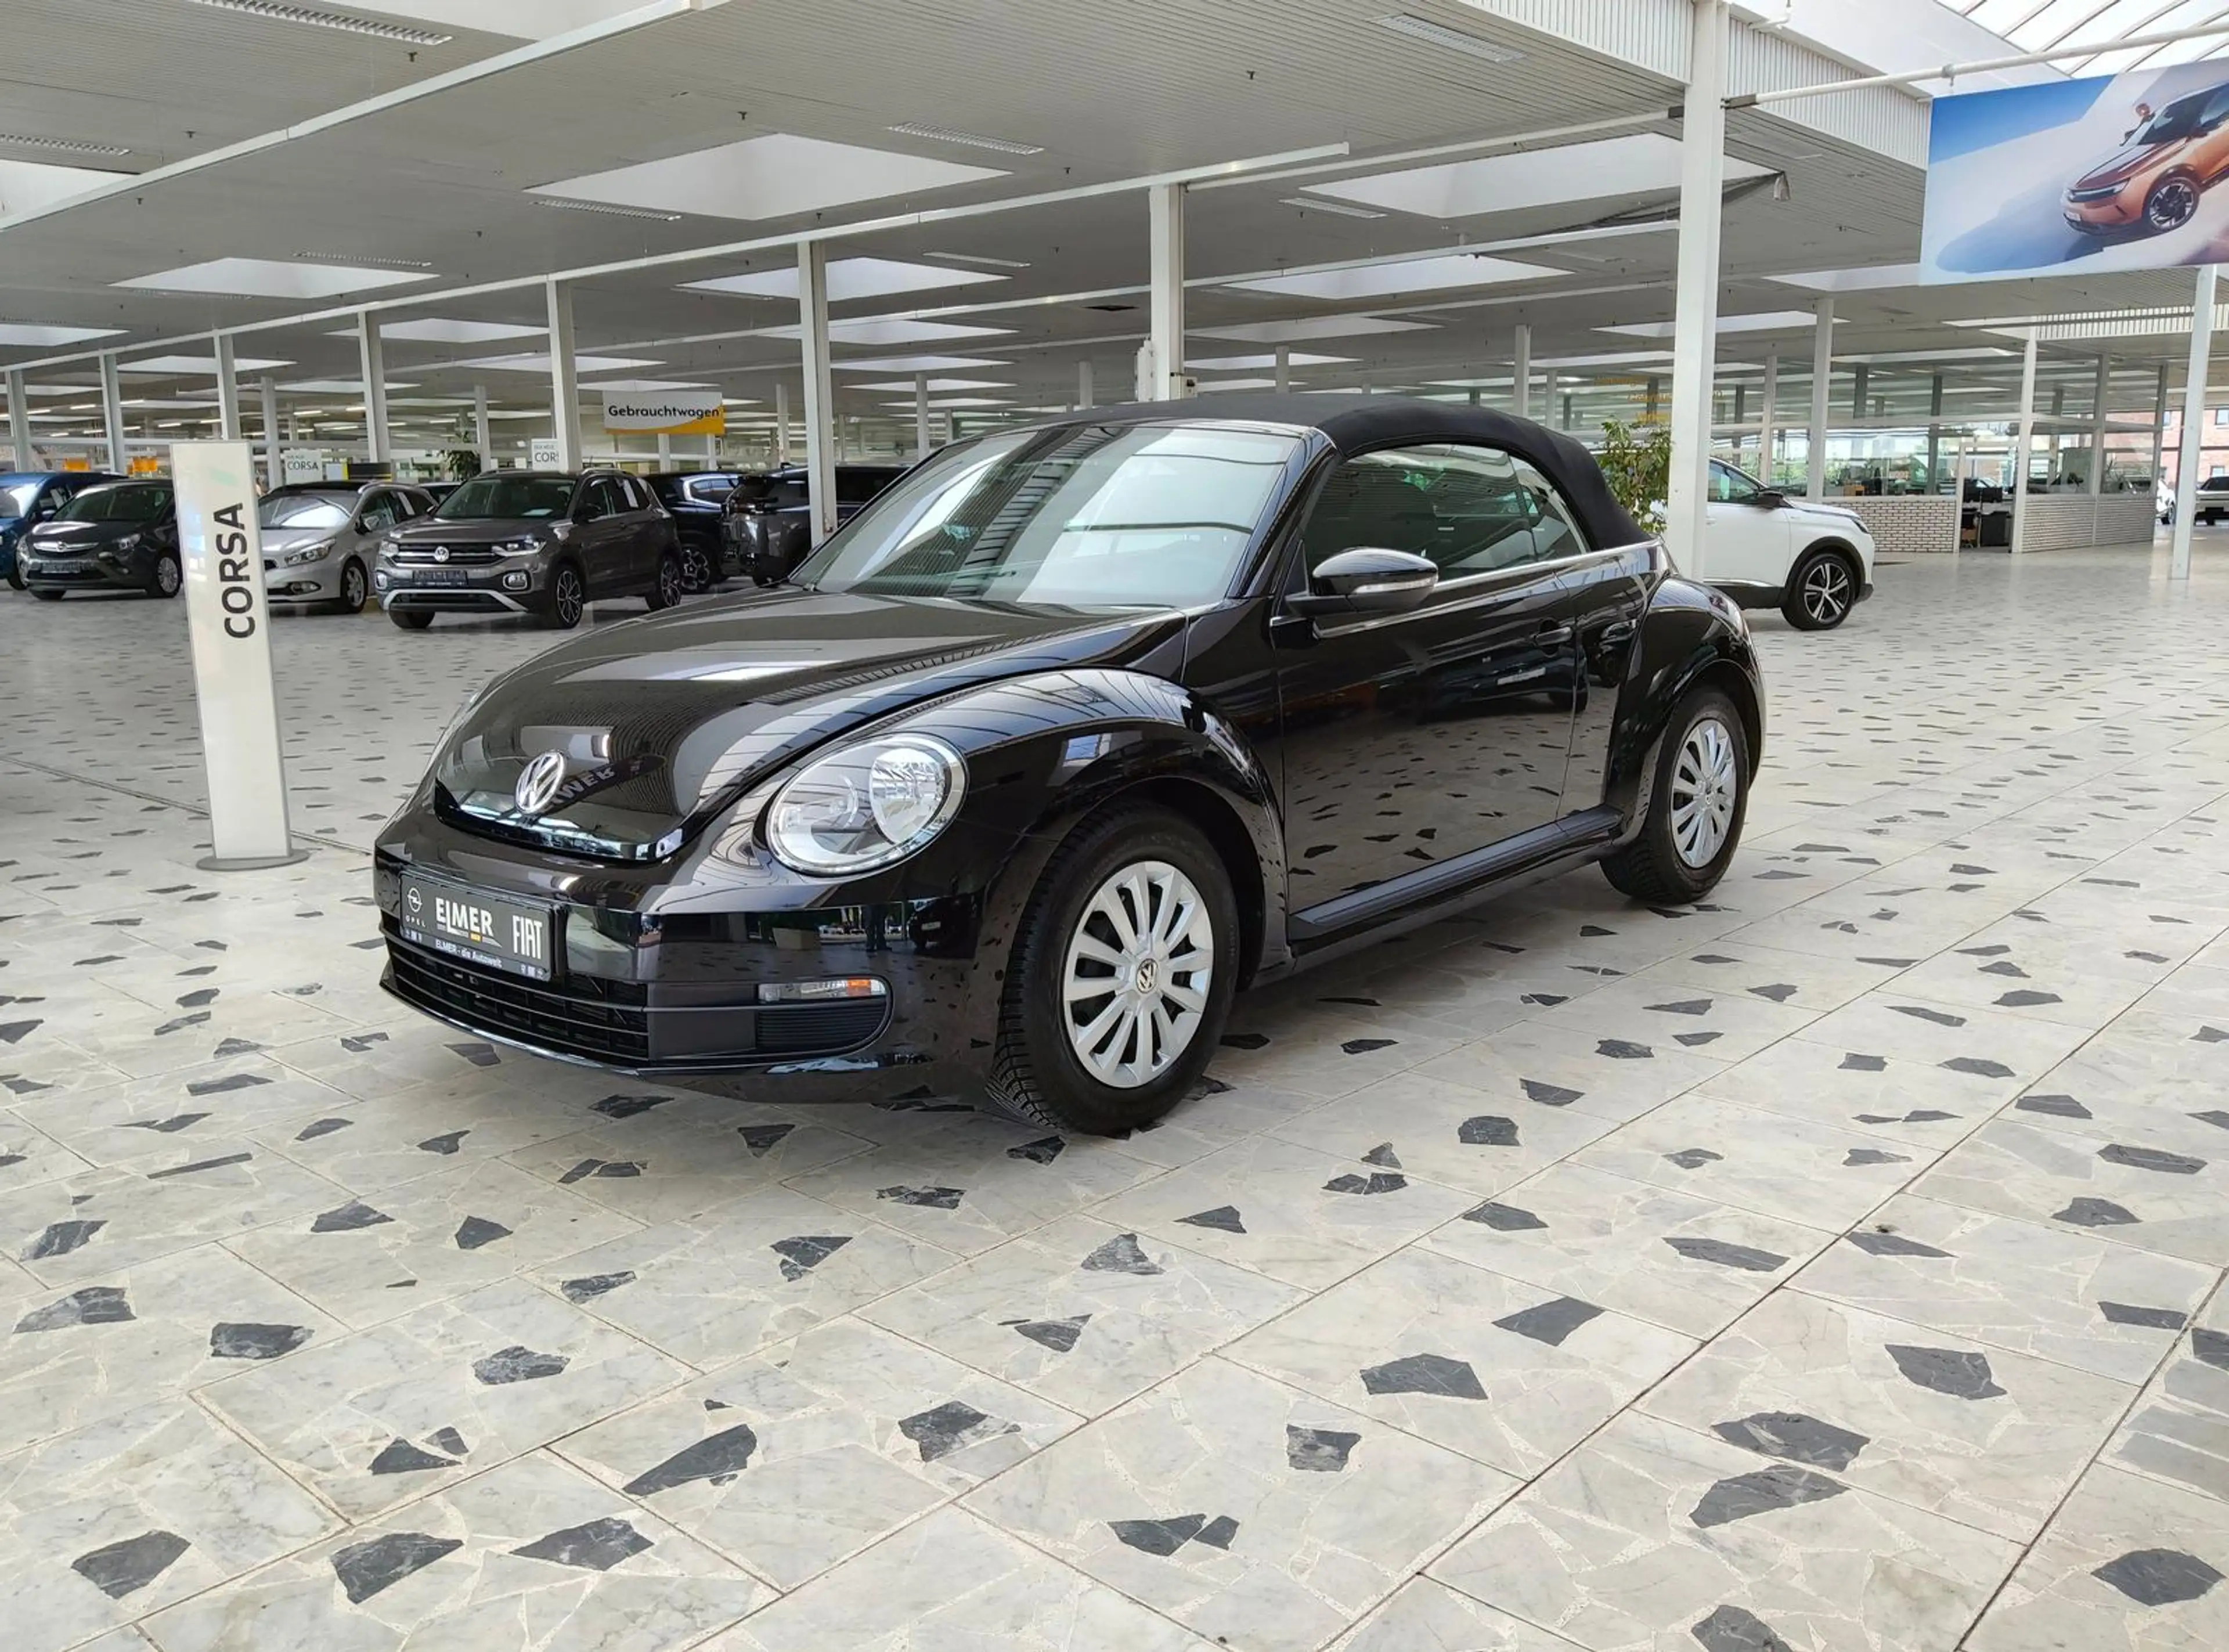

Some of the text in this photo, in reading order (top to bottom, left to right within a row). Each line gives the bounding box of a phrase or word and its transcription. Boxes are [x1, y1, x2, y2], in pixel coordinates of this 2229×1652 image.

[608, 405, 720, 420] Gebrauchtwagen
[287, 461, 319, 471] CORSA
[213, 503, 256, 639] CORSA
[405, 915, 425, 928] OPEL
[435, 897, 494, 937] ELMER
[512, 914, 543, 960] FIAT
